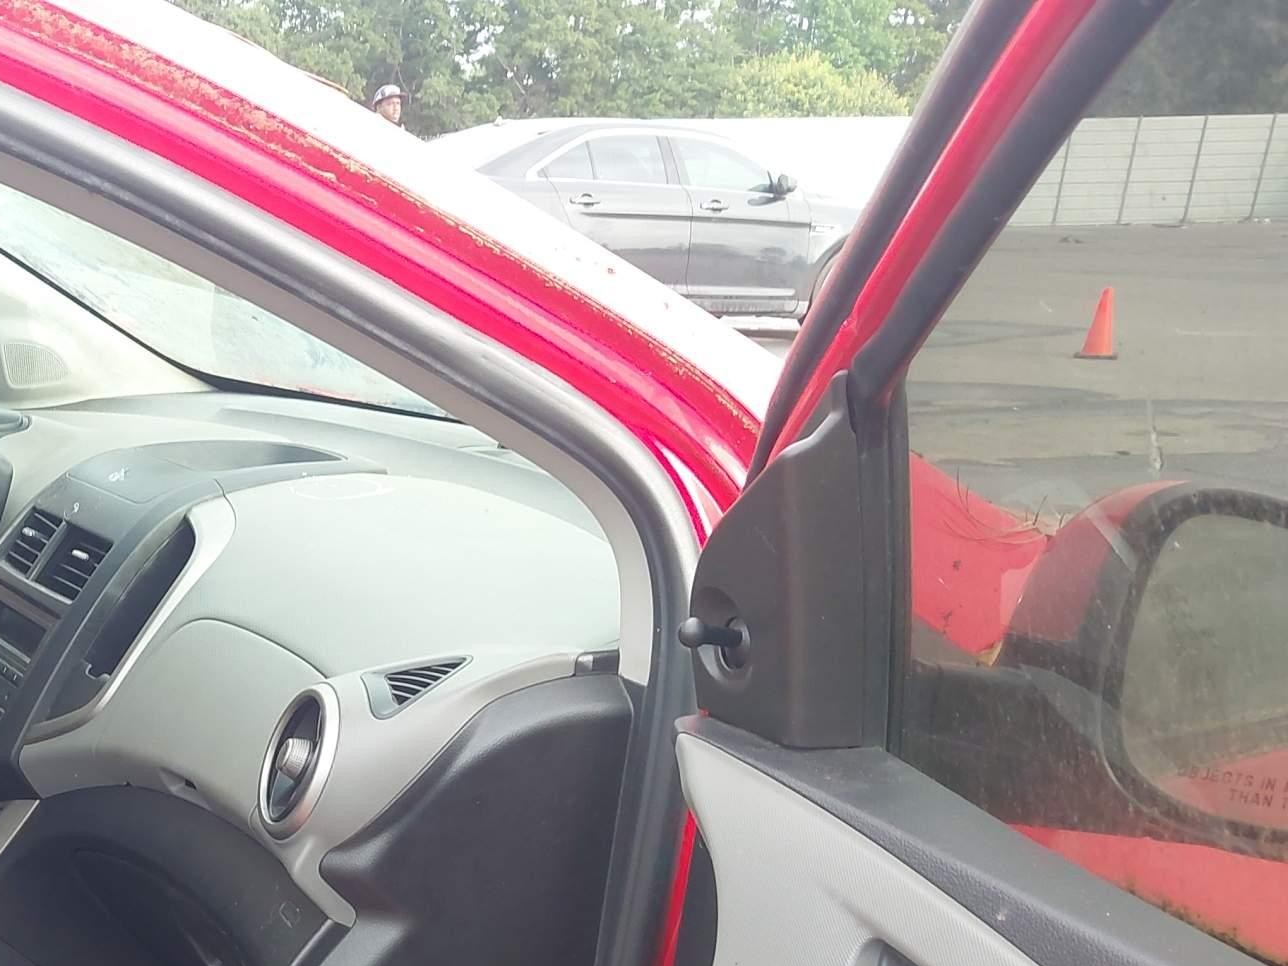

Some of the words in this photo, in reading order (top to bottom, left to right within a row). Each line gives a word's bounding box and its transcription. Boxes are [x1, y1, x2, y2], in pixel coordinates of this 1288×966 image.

[1177, 765, 1254, 788] OBJECTS
[1260, 777, 1276, 792] IN
[1230, 788, 1274, 808] THAN
